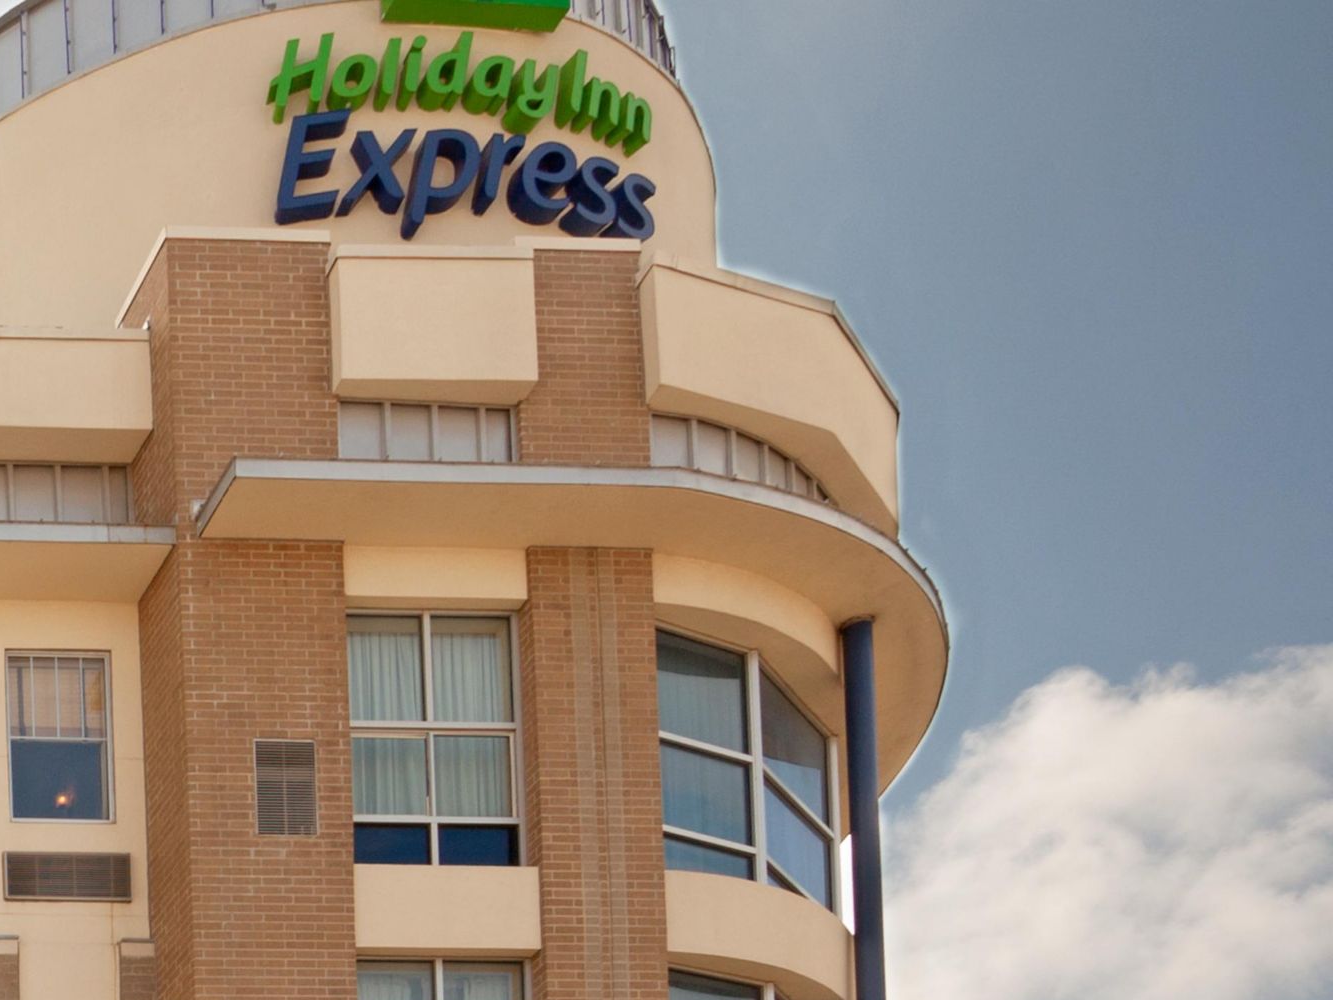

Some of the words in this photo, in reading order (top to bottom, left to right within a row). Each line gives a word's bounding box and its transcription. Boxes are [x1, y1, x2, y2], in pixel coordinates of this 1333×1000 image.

[267, 31, 560, 134] Holiday
[554, 49, 653, 158] Inn
[274, 107, 657, 241] Express
